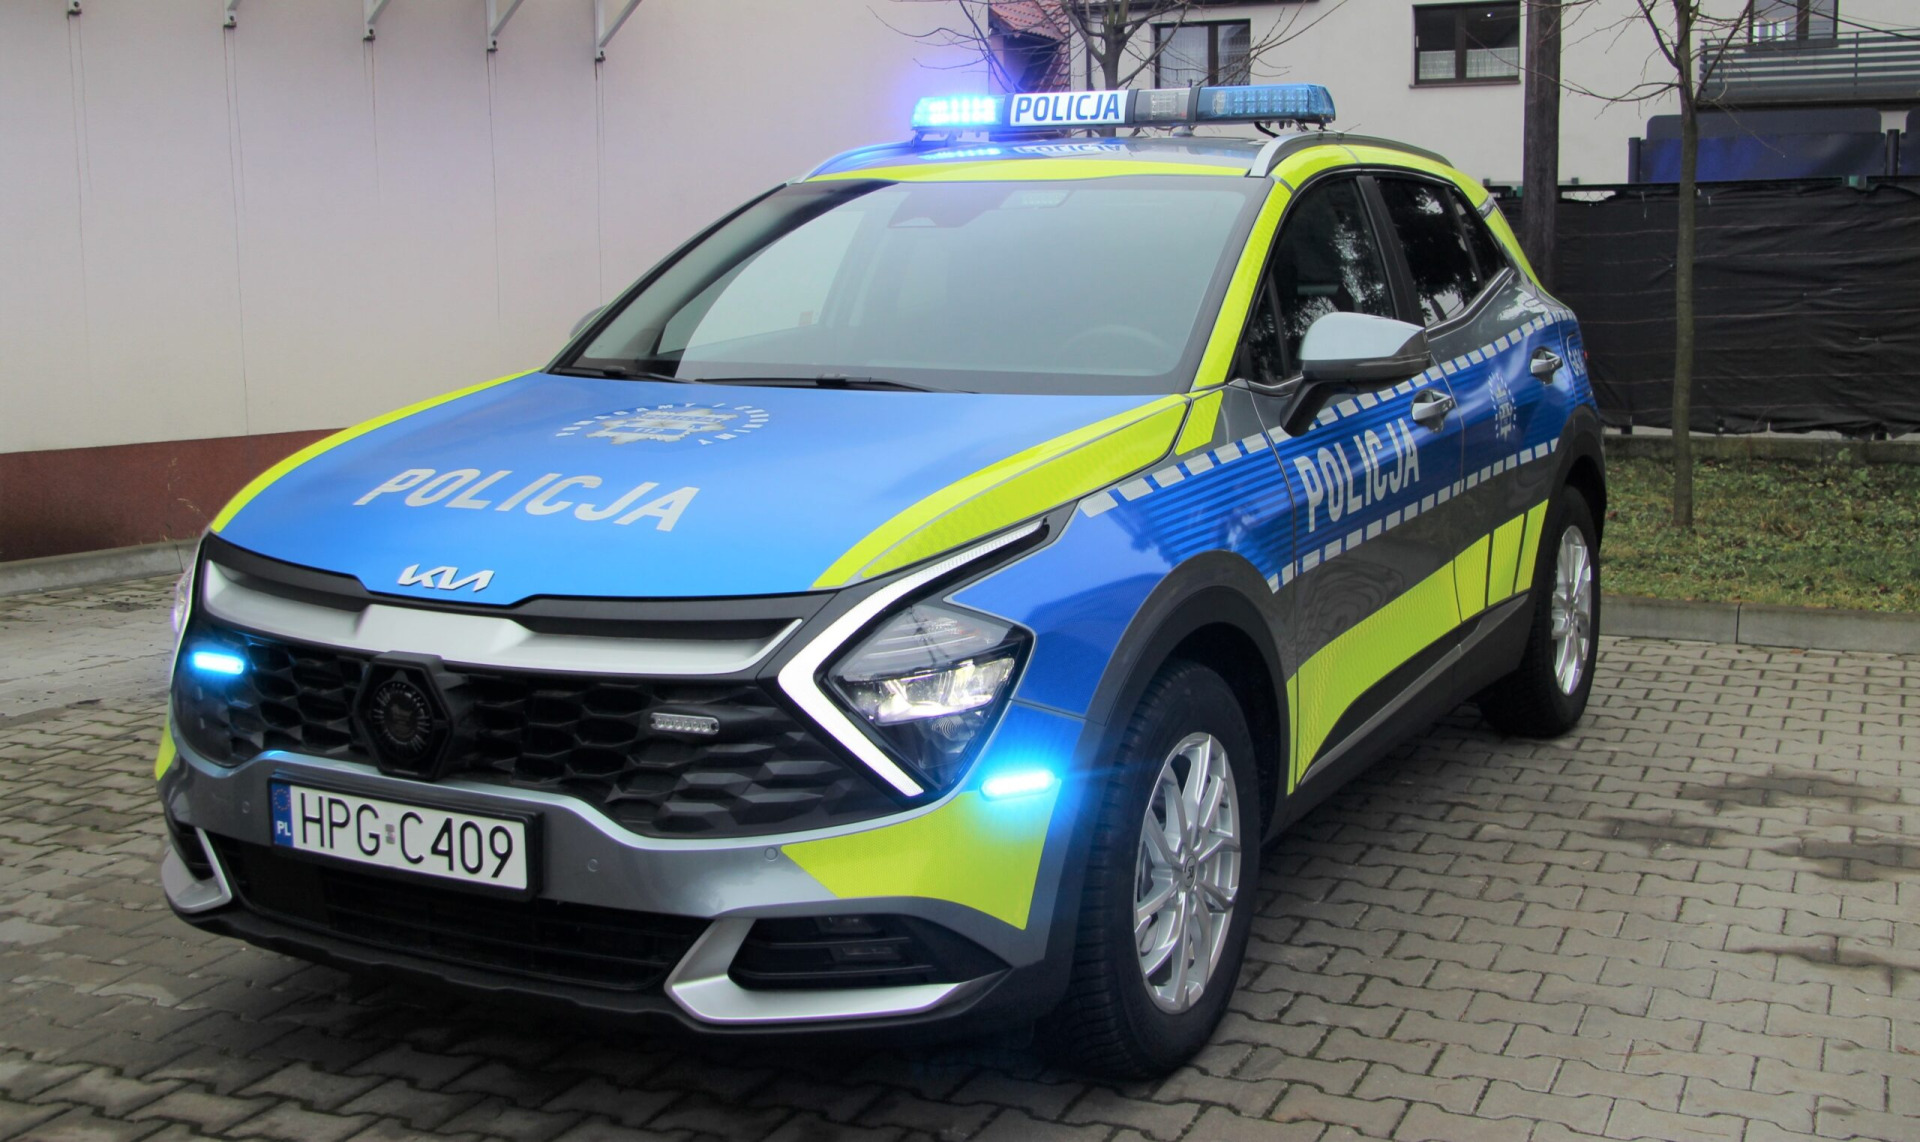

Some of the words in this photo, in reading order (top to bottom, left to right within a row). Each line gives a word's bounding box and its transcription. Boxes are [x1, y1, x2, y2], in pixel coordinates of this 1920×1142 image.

[1015, 93, 1120, 122] POLICJA
[354, 469, 700, 532] POLICJA
[1293, 418, 1419, 533] POLICJA
[397, 563, 495, 592] KIA
[276, 820, 292, 837] PL
[301, 792, 381, 856] HPG
[400, 811, 514, 879] C409
